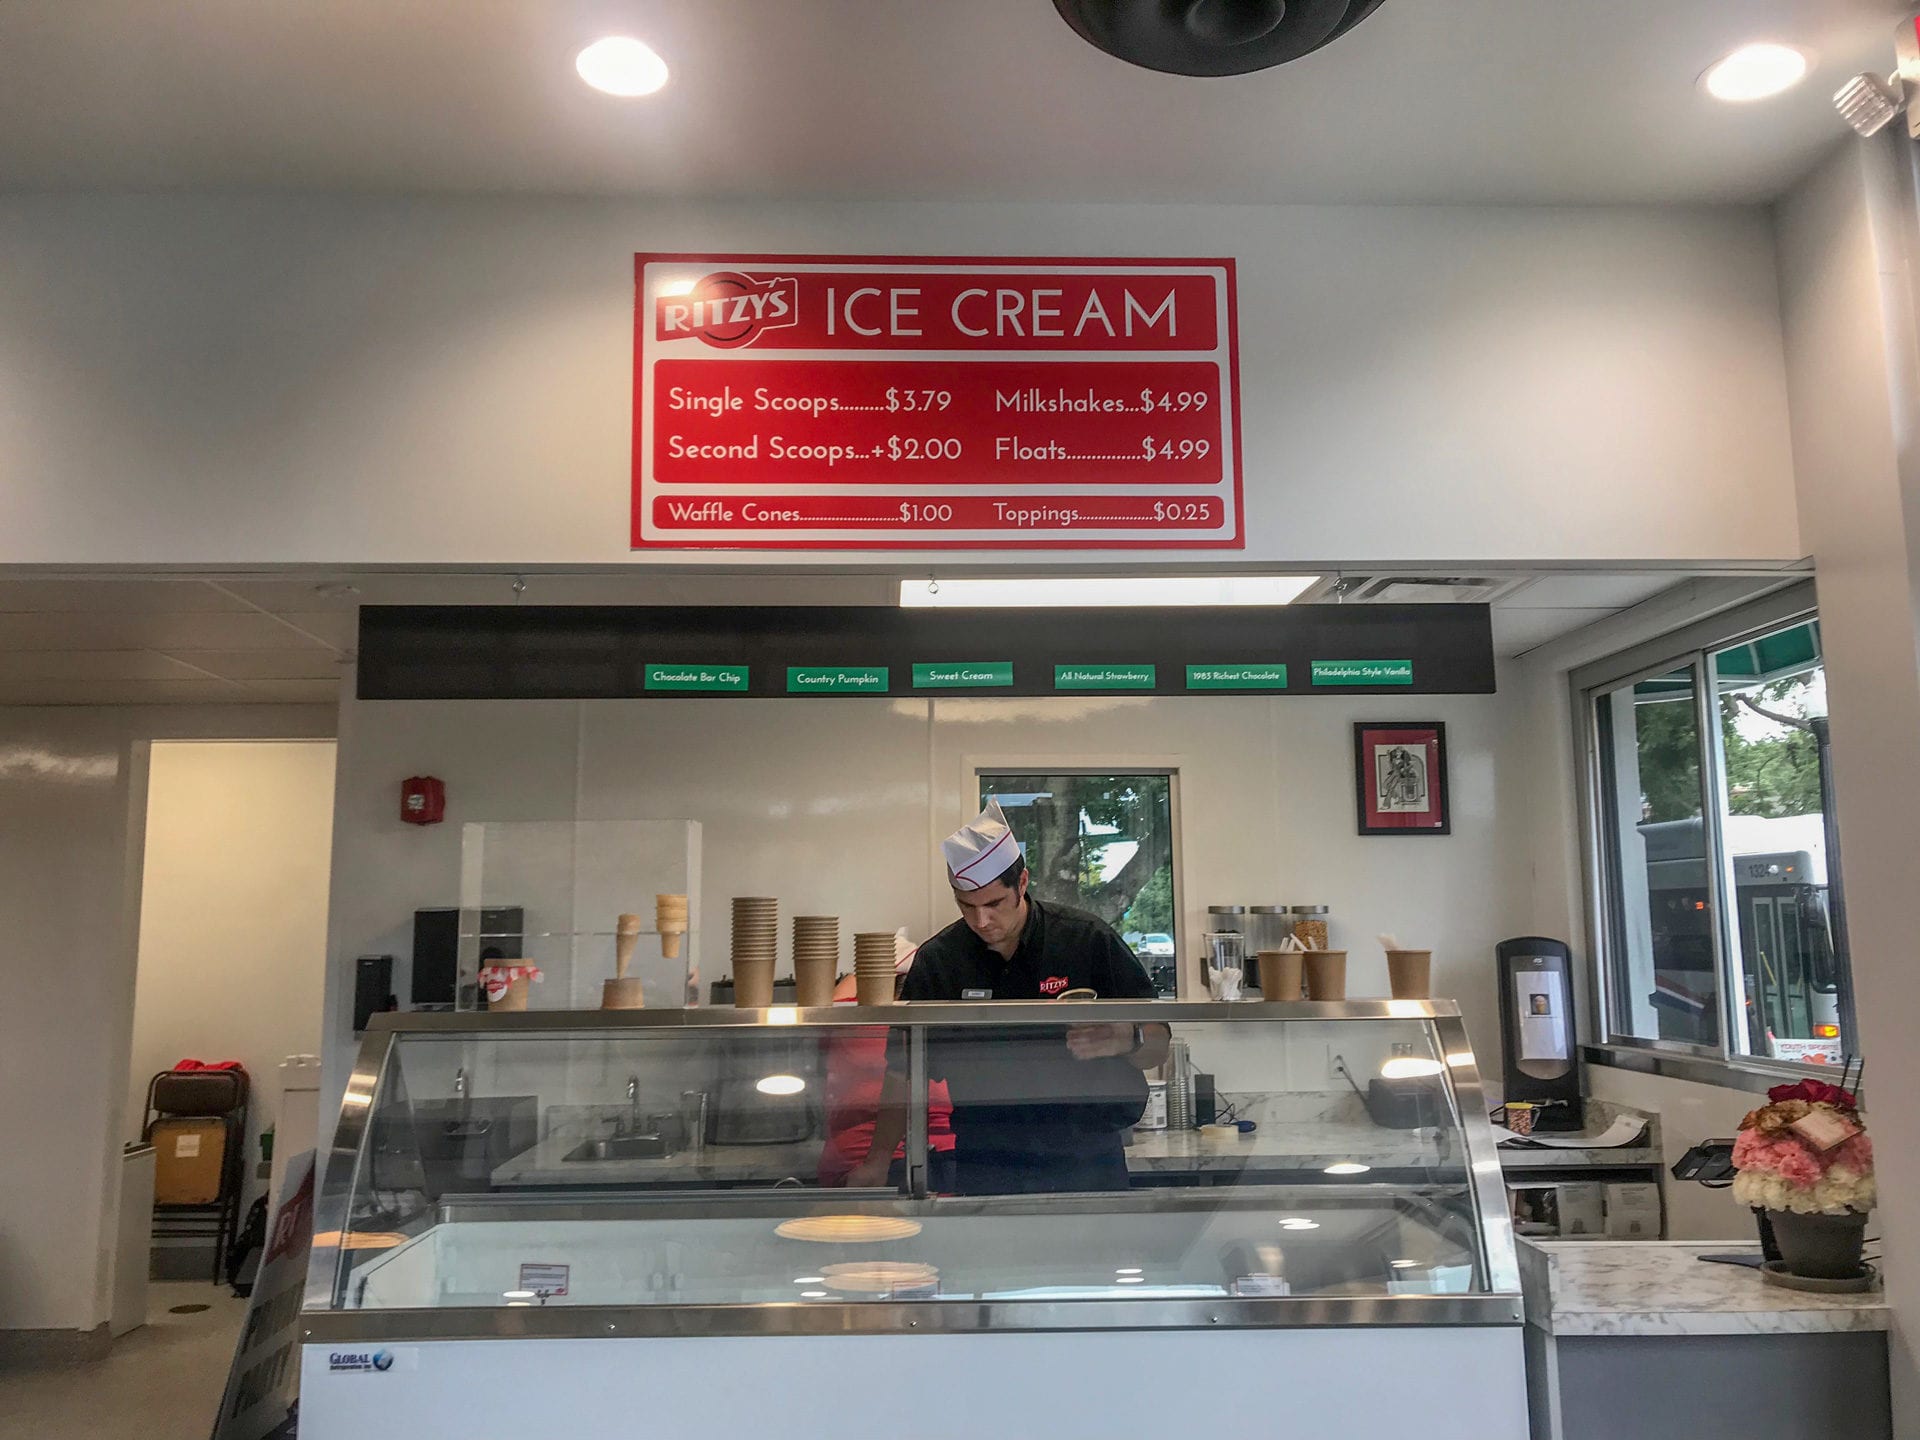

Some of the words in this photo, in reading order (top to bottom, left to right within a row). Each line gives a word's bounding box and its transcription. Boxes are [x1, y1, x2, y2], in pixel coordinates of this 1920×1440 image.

[664, 277, 789, 332] RITZY'S
[827, 287, 922, 337] ICE
[951, 287, 1177, 337] CREAM
[668, 386, 744, 417] Single
[668, 435, 759, 459] Second
[668, 502, 733, 522] Waffle
[652, 671, 698, 682] Chocolate
[700, 672, 716, 682] Bar
[718, 672, 741, 685] Chip
[929, 671, 959, 681] Sweet
[961, 670, 993, 680] Cream
[1061, 671, 1073, 680] All
[1074, 671, 1105, 681] Natural
[1105, 671, 1149, 682] Strawberry
[1213, 671, 1241, 681] Richest
[1241, 671, 1280, 681] Chocolate
[1313, 666, 1361, 678] Philadelphia
[1362, 666, 1382, 678] Style
[1383, 666, 1411, 676] Vanilla
[797, 673, 835, 686] Country
[838, 673, 879, 686] Pumpkin
